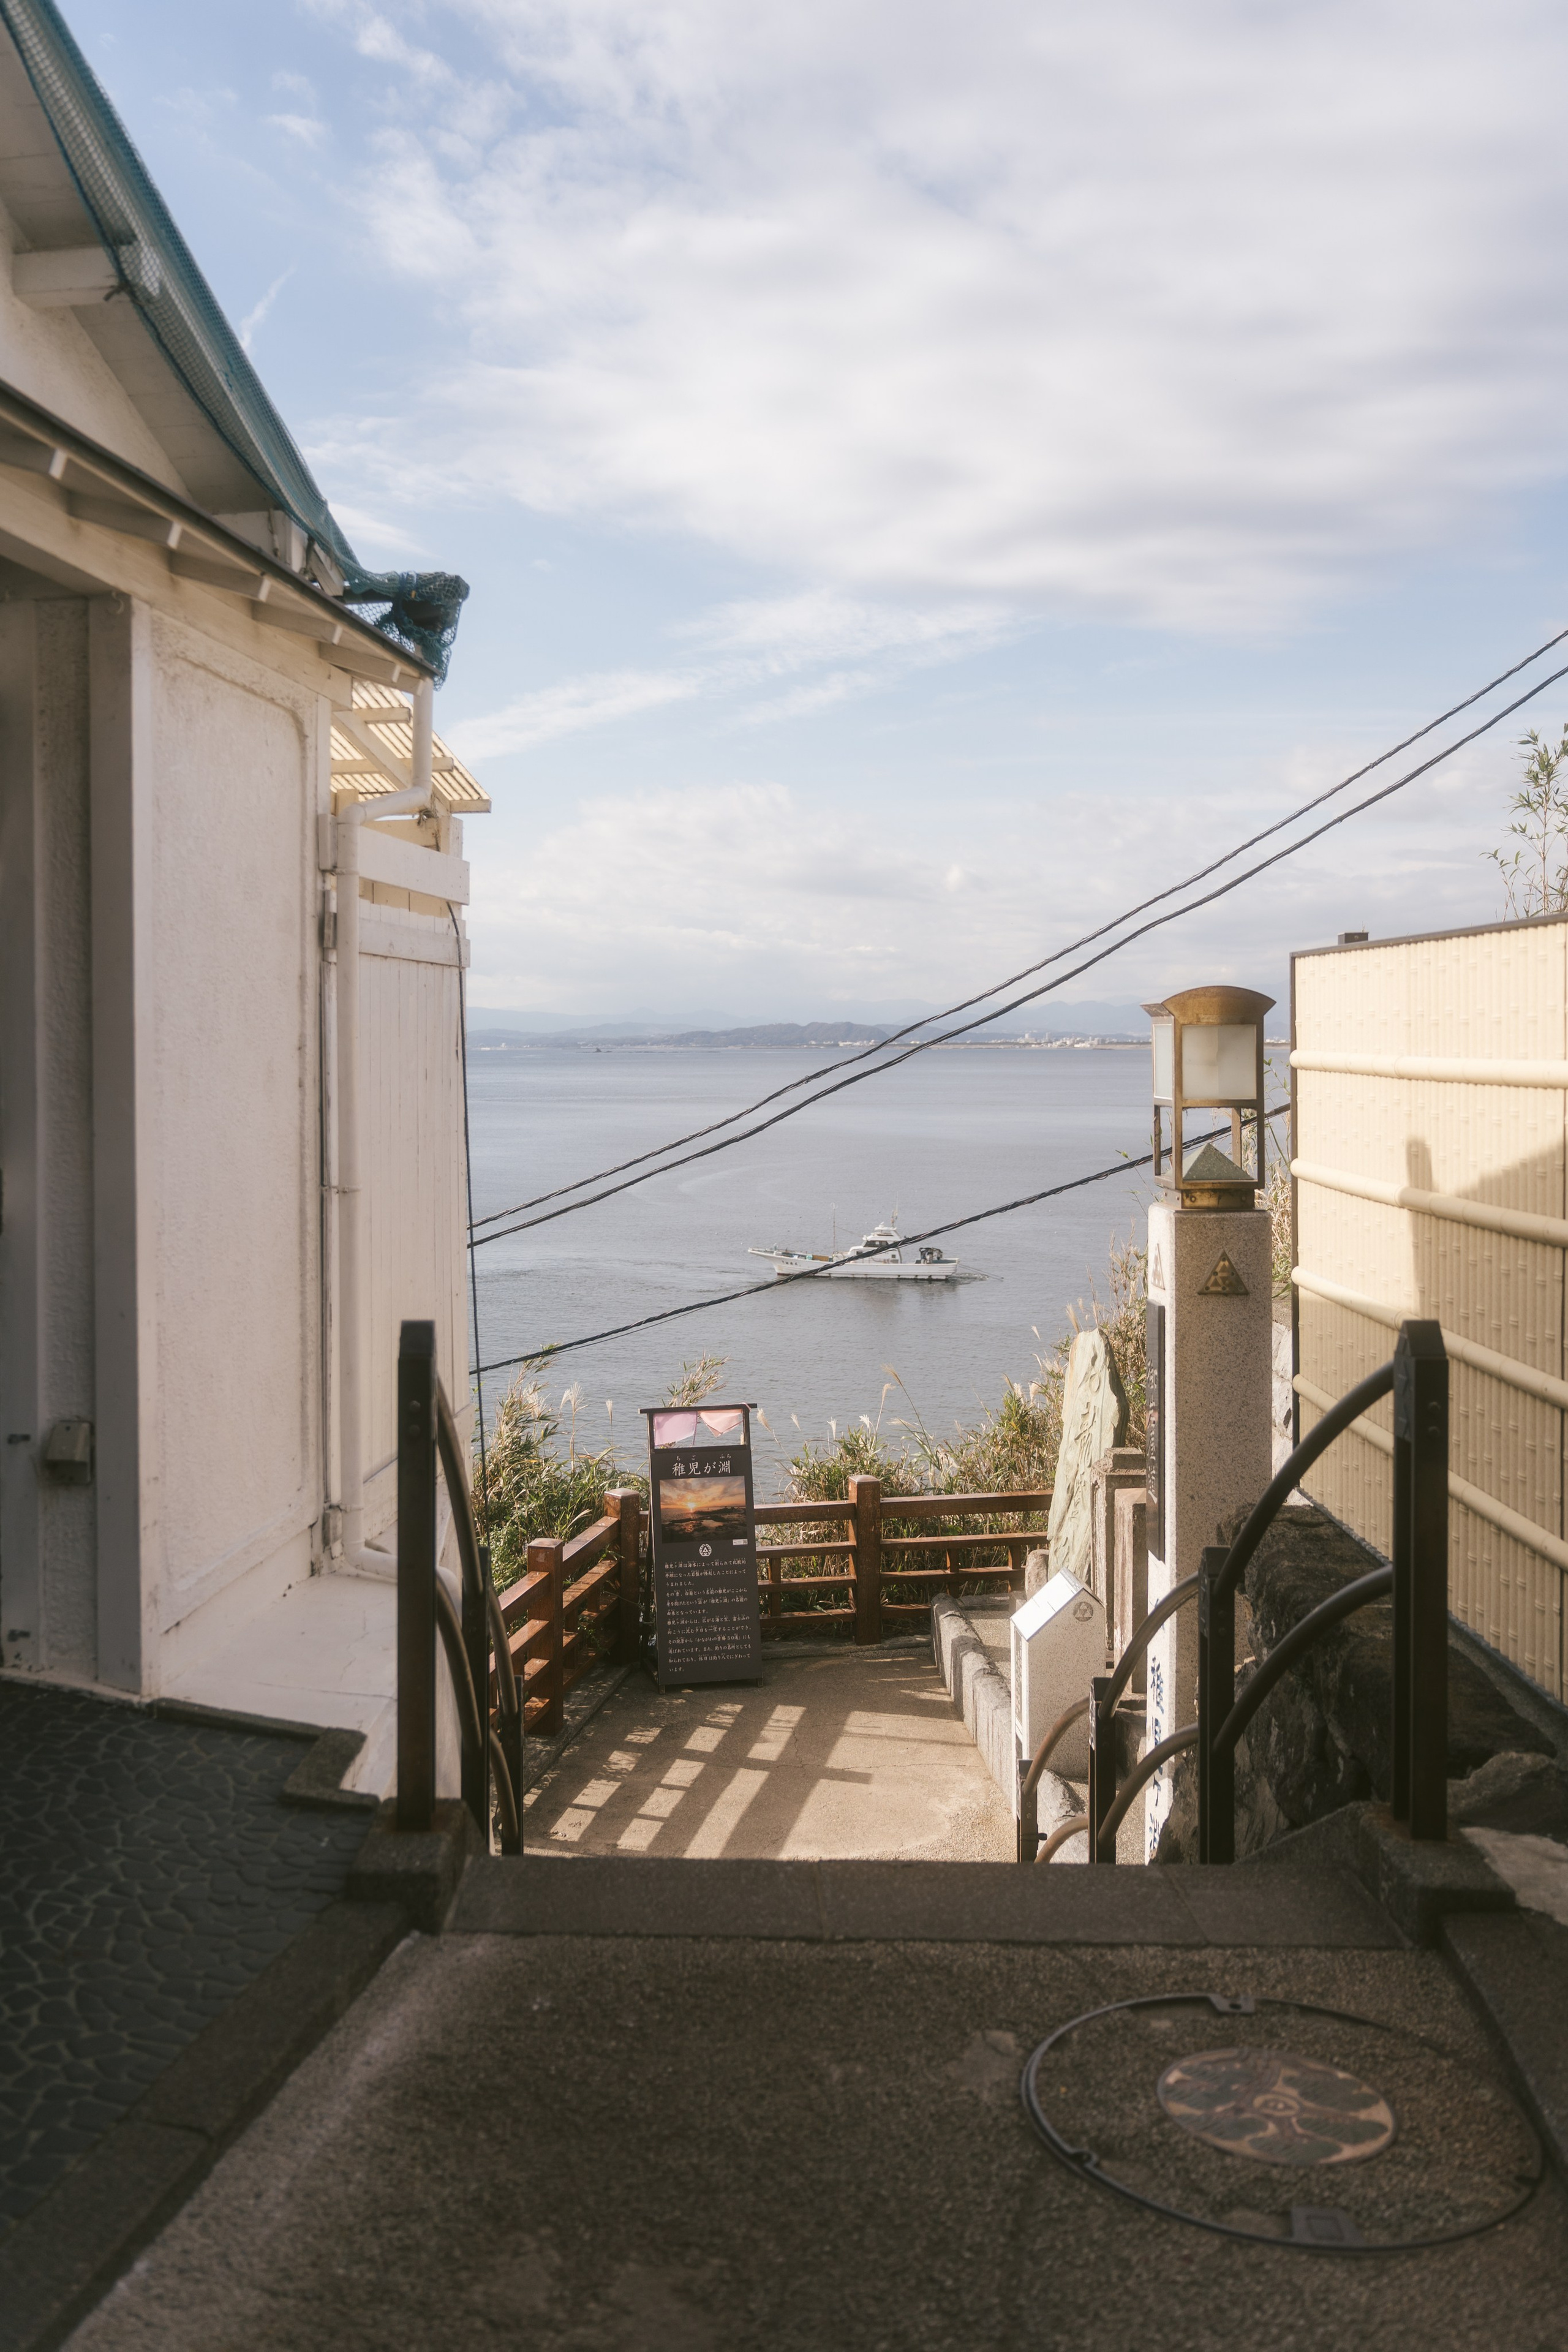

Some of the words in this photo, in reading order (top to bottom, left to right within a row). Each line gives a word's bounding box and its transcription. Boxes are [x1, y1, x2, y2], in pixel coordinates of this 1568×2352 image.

[672, 1460, 731, 1476] 稚児が淵
[1147, 1359, 1158, 1504] 御岩屋道
